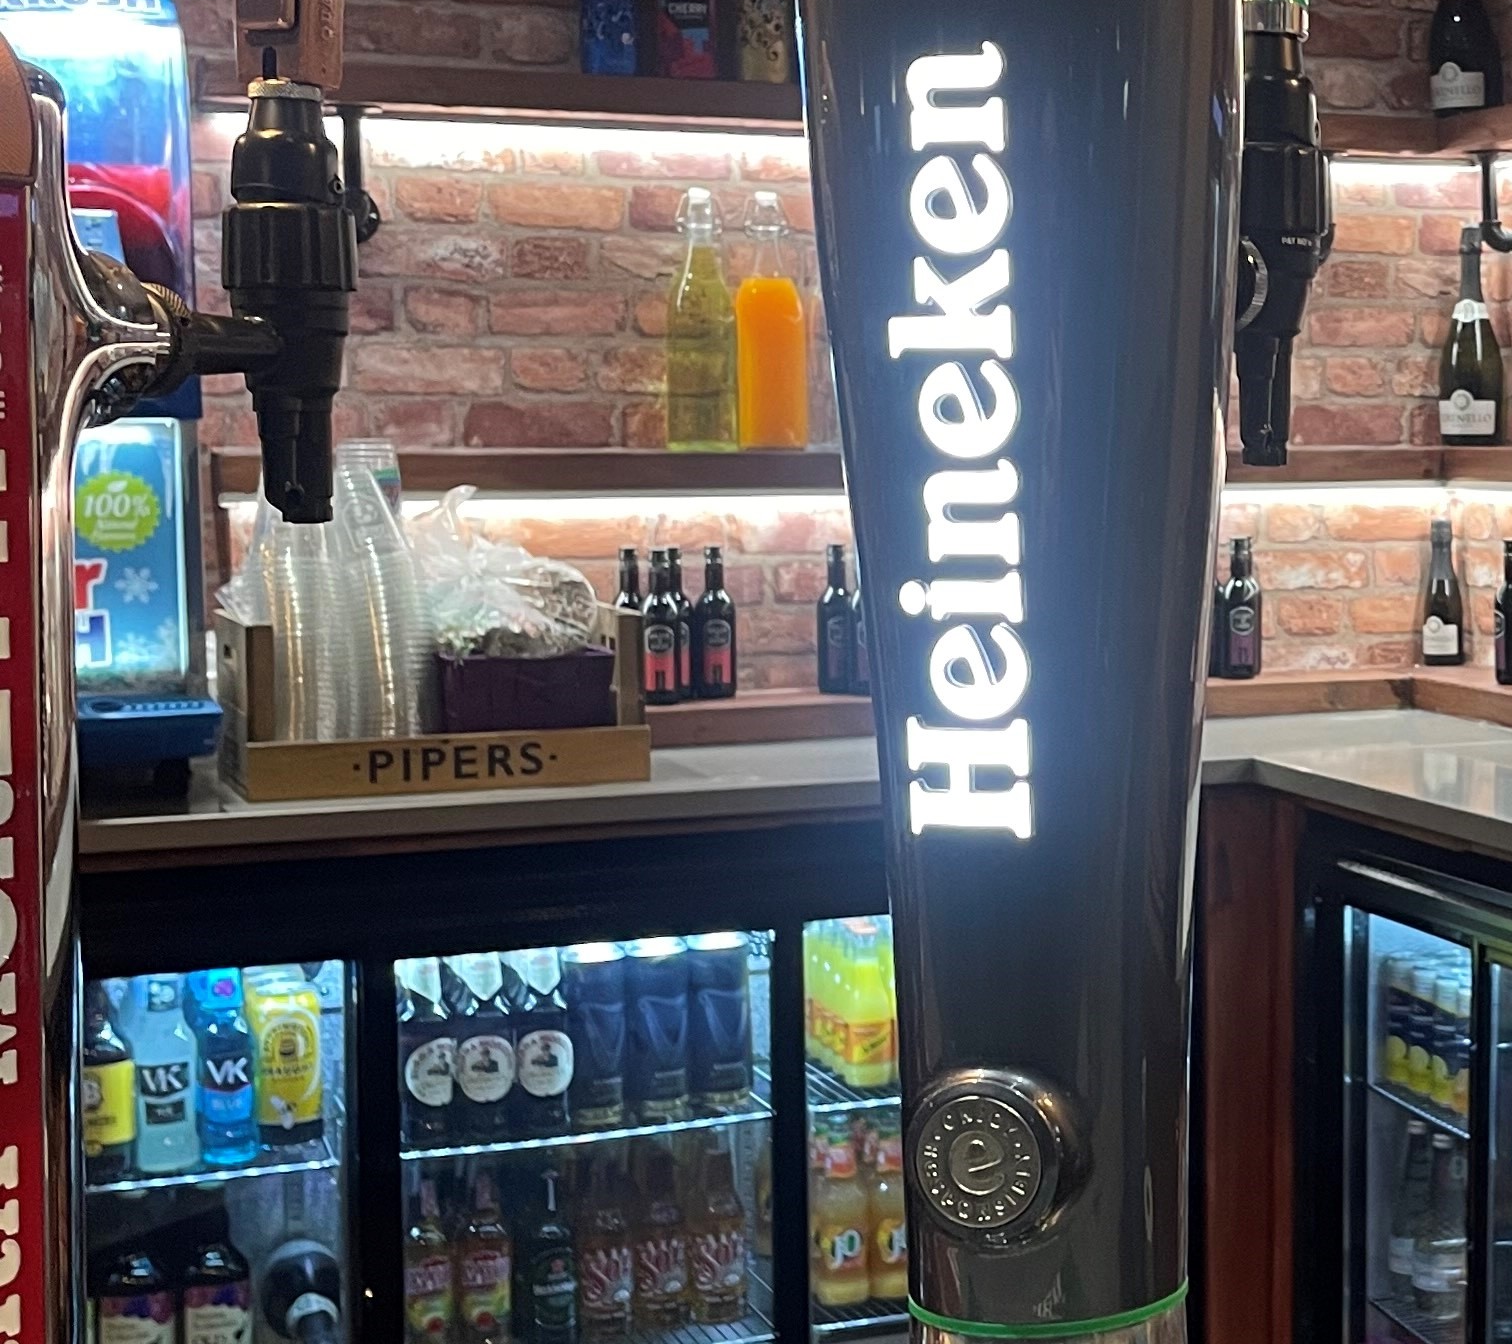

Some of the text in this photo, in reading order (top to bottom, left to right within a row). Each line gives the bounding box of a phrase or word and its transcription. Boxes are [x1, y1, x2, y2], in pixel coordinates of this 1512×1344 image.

[888, 39, 1036, 839] Heineken
[81, 491, 152, 519] 100%
[368, 741, 545, 785] PIPERS
[141, 1064, 185, 1093] VK
[205, 1057, 250, 1086] VK
